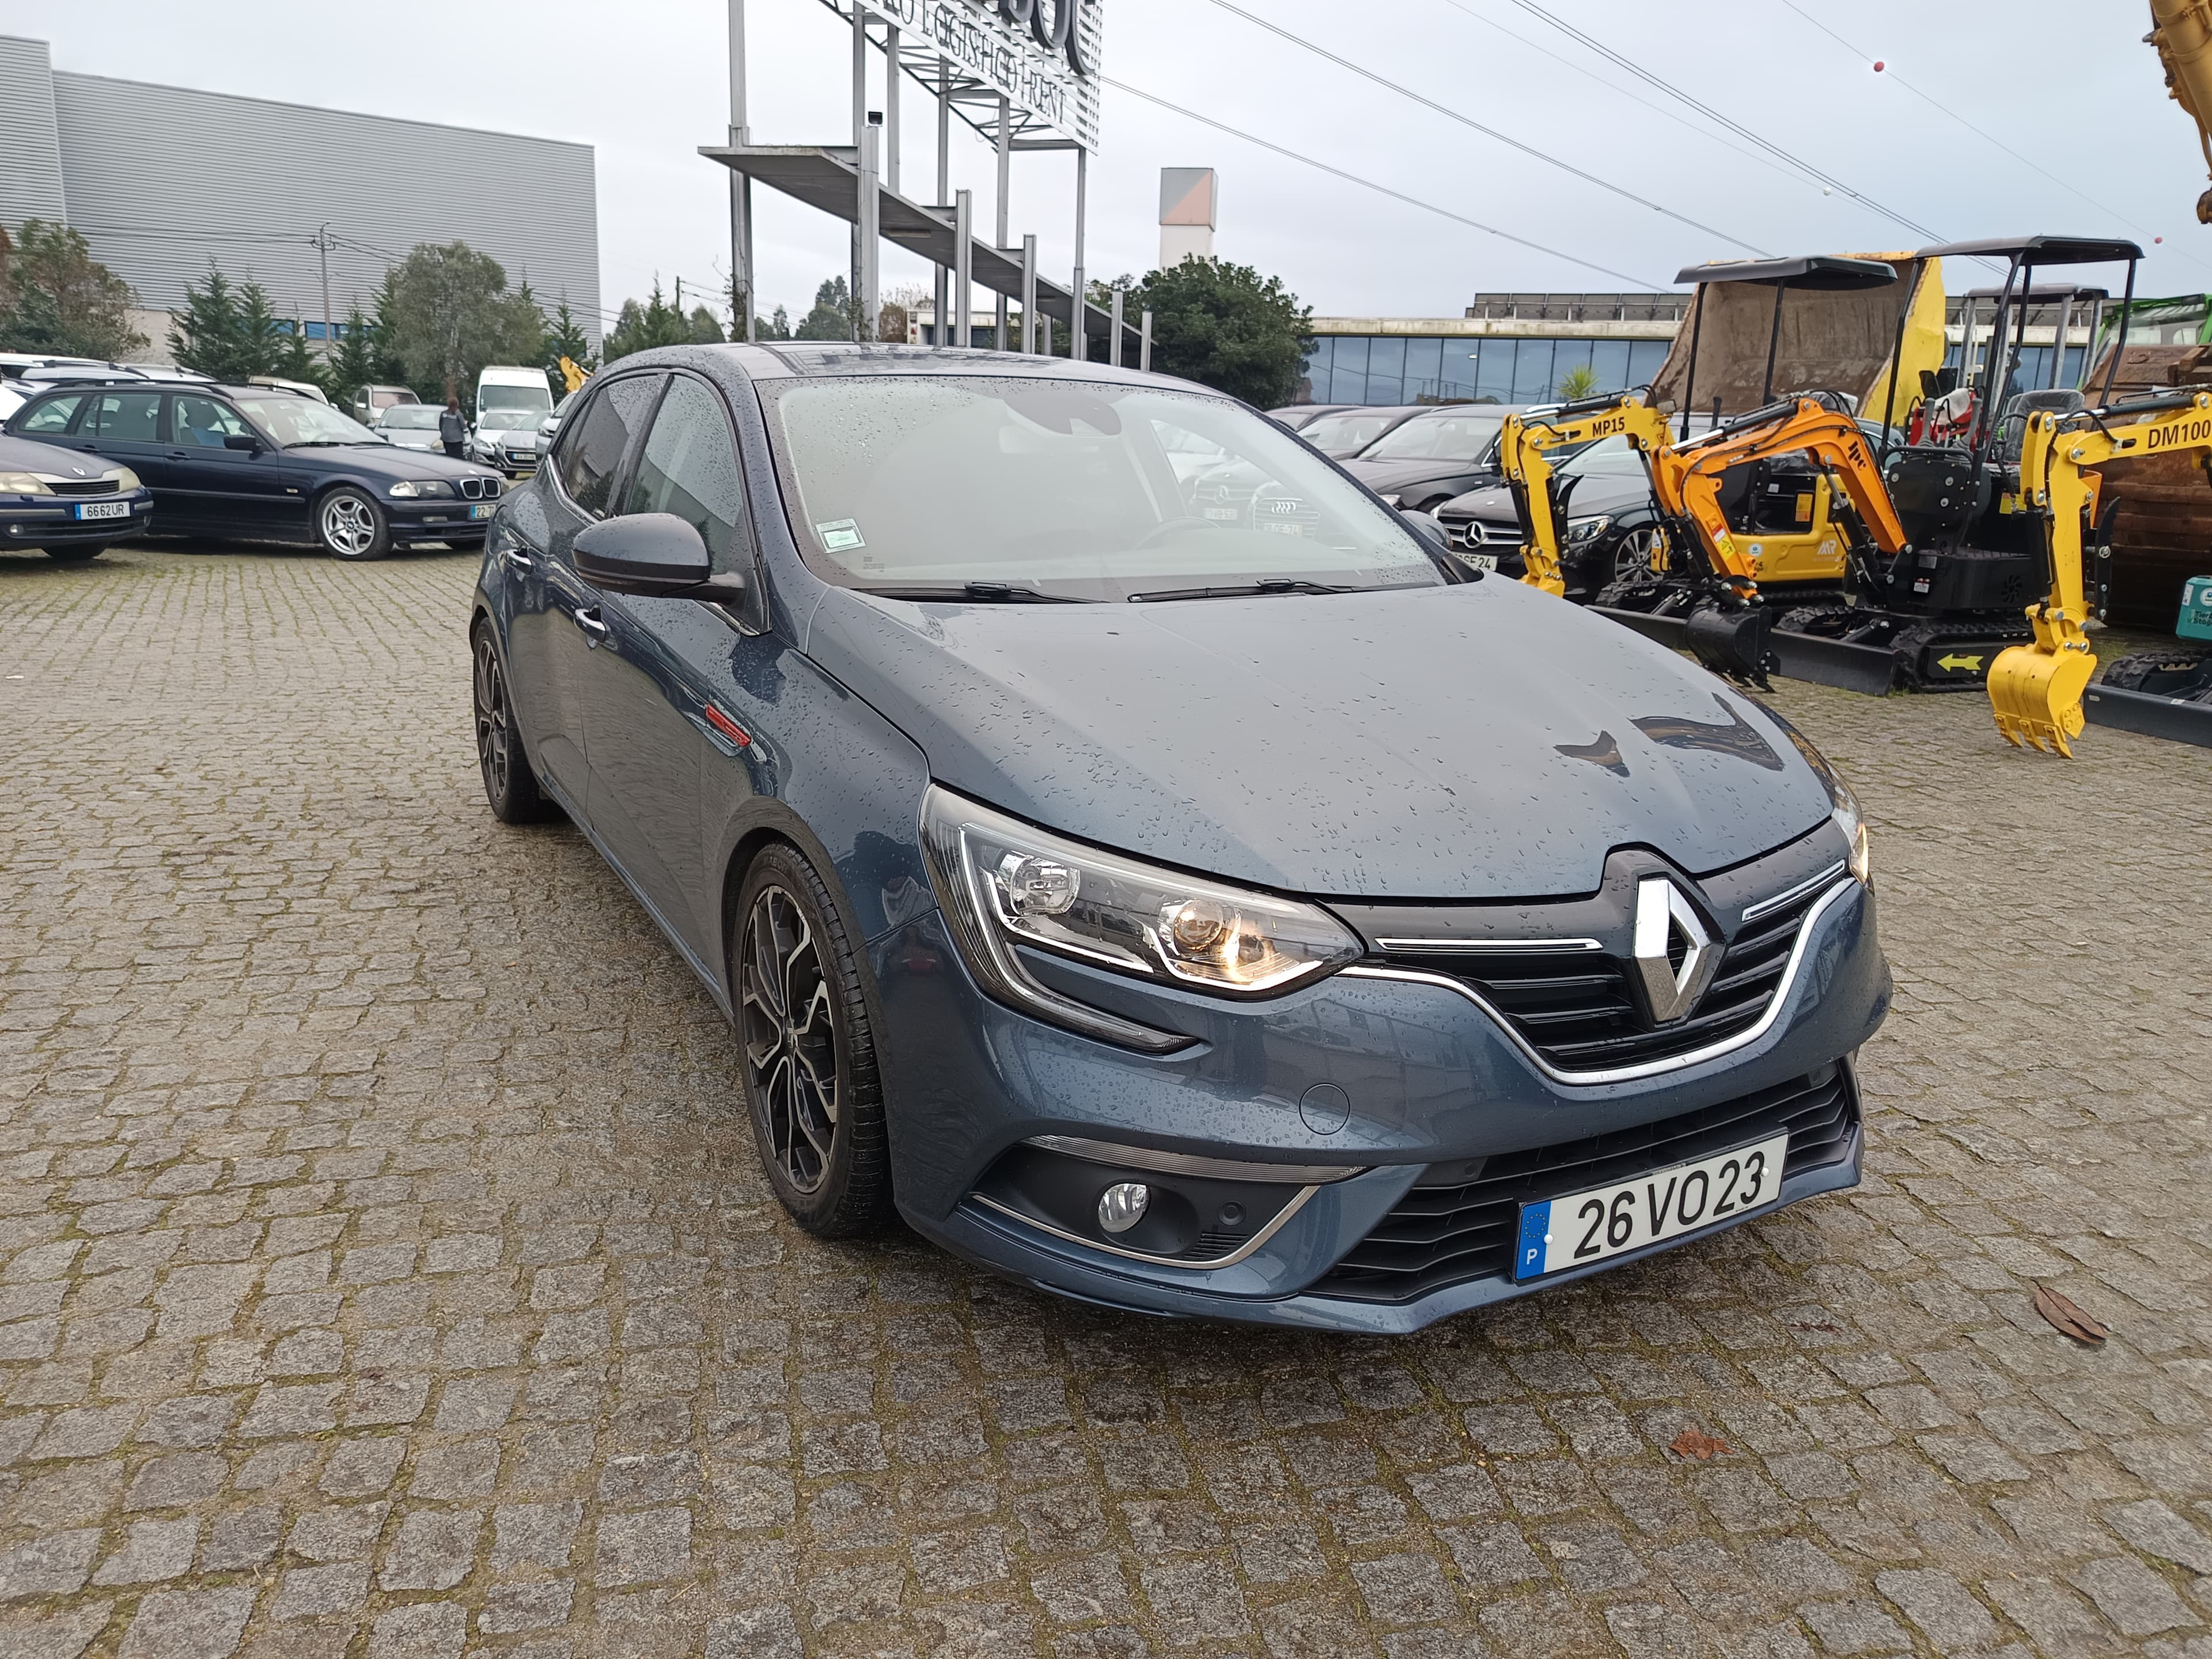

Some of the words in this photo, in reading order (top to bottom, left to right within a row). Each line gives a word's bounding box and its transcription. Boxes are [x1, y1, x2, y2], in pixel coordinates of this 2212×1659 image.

[1592, 416, 1625, 437] MP15
[2147, 419, 2211, 449] DM100
[1527, 1248, 1538, 1265] P
